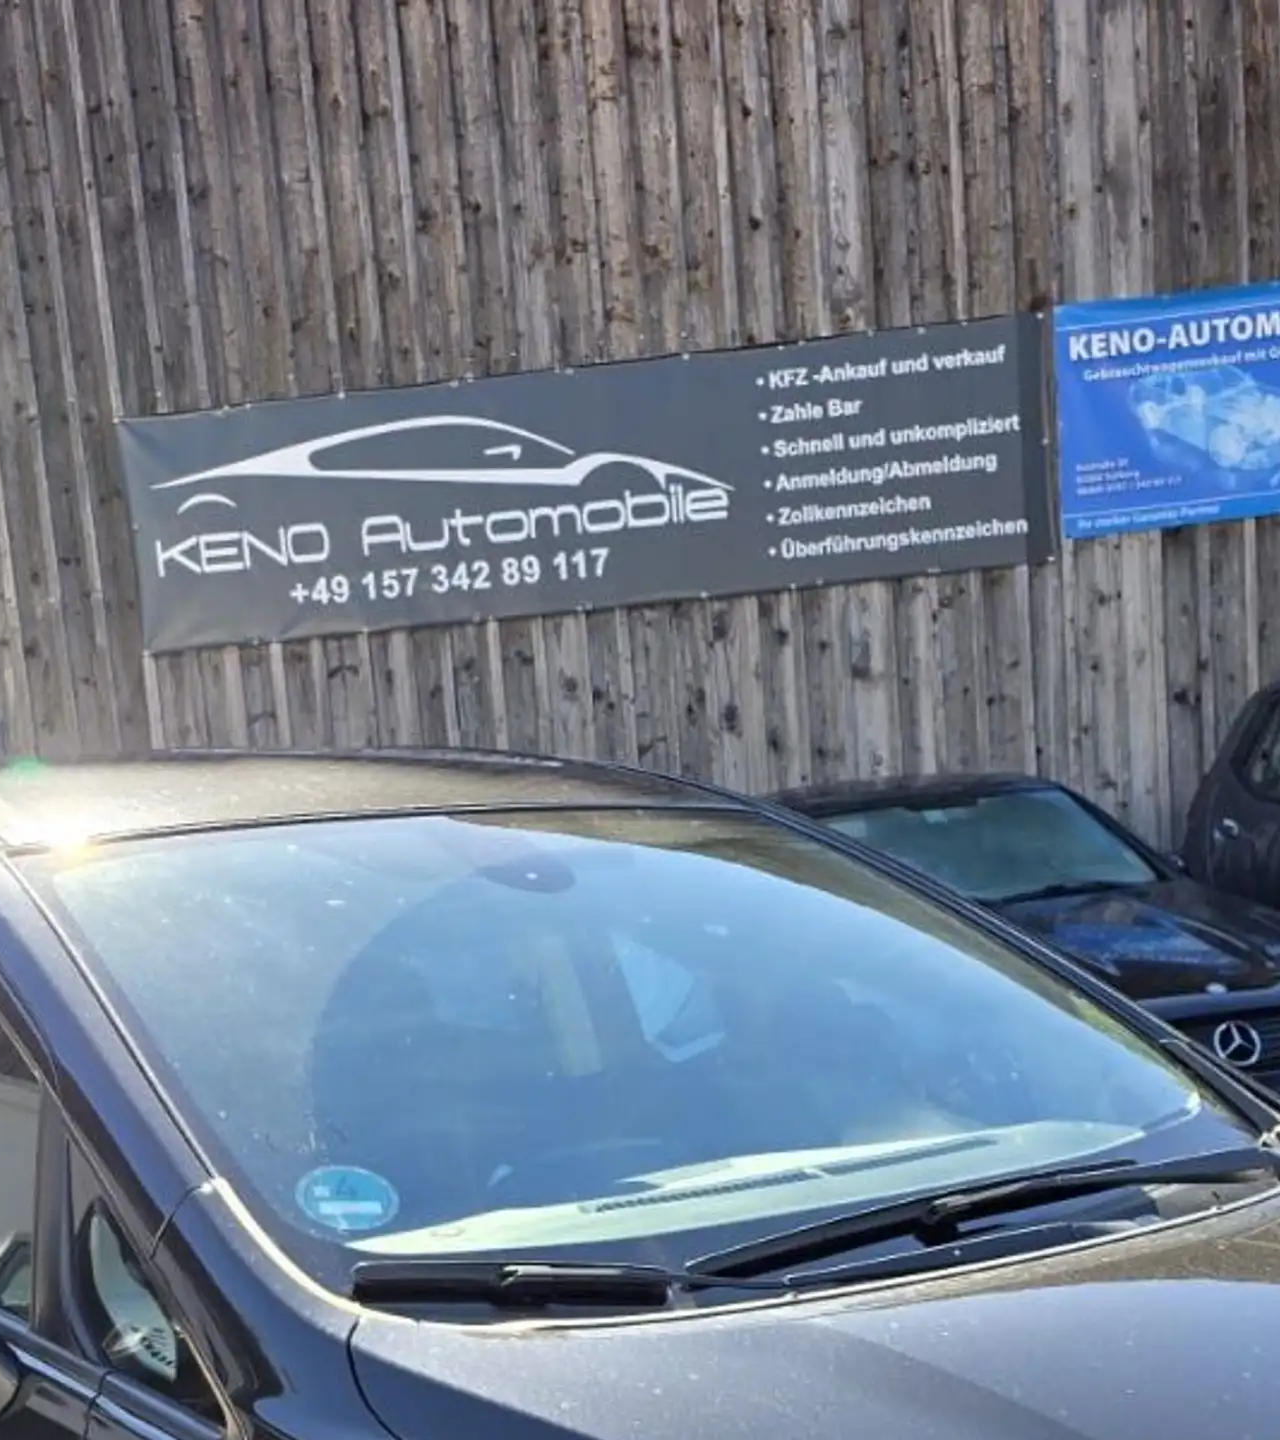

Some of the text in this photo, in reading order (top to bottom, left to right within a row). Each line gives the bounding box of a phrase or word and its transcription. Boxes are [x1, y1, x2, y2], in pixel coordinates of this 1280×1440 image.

[769, 368, 809, 389] KFZ
[892, 354, 928, 376] und
[933, 344, 1006, 370] verkauf
[770, 398, 863, 424] Zahle Bar
[773, 414, 1020, 458] Schnell und unkompliziert
[775, 452, 998, 492] Anmeldung/Abmeldung
[155, 483, 729, 578] KENO Automobile
[777, 494, 932, 526] Zollkennzeichen
[780, 517, 1029, 559] Überführungskennzeichen
[289, 548, 610, 605] +49 157 342 89 117
